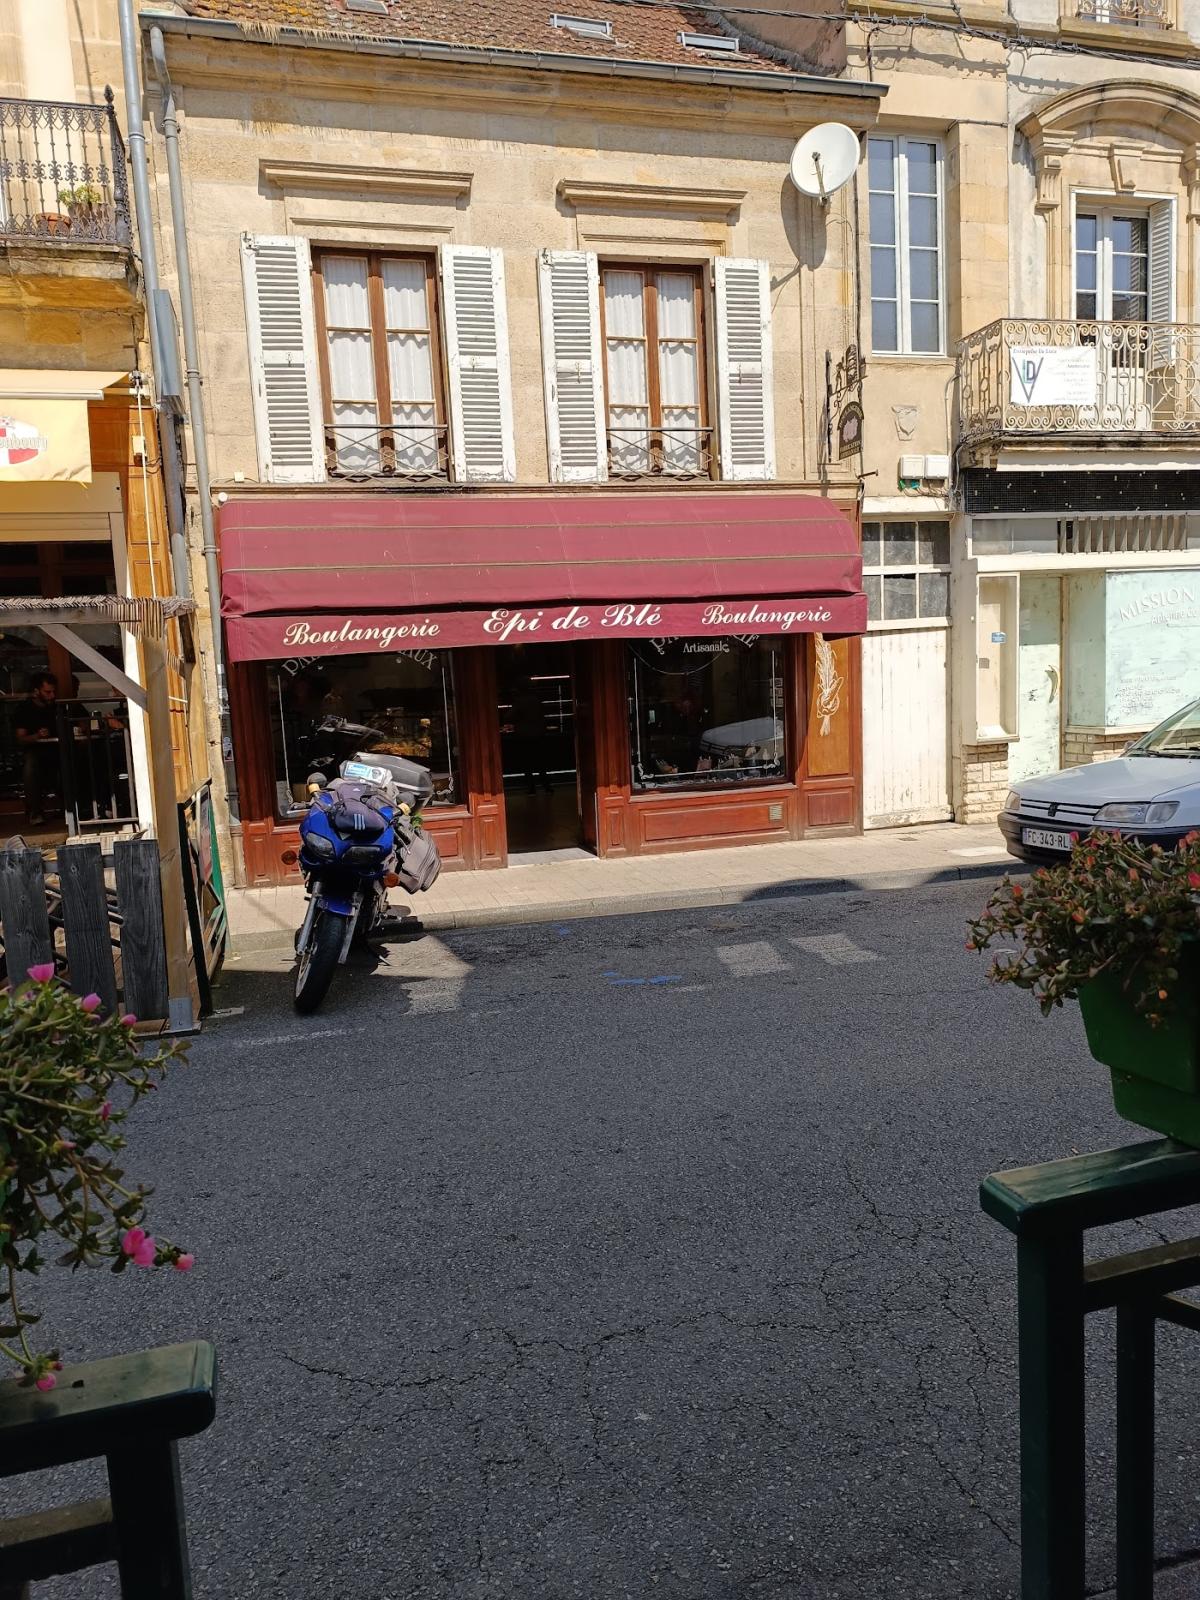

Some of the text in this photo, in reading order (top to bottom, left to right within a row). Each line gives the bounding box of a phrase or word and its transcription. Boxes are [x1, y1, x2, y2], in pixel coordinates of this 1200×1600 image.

[483, 603, 663, 641] Epi de Blé
[701, 604, 833, 631] Boulangerie
[283, 619, 441, 648] Boulangerie
[1028, 830, 1068, 849] FC-343-RL
